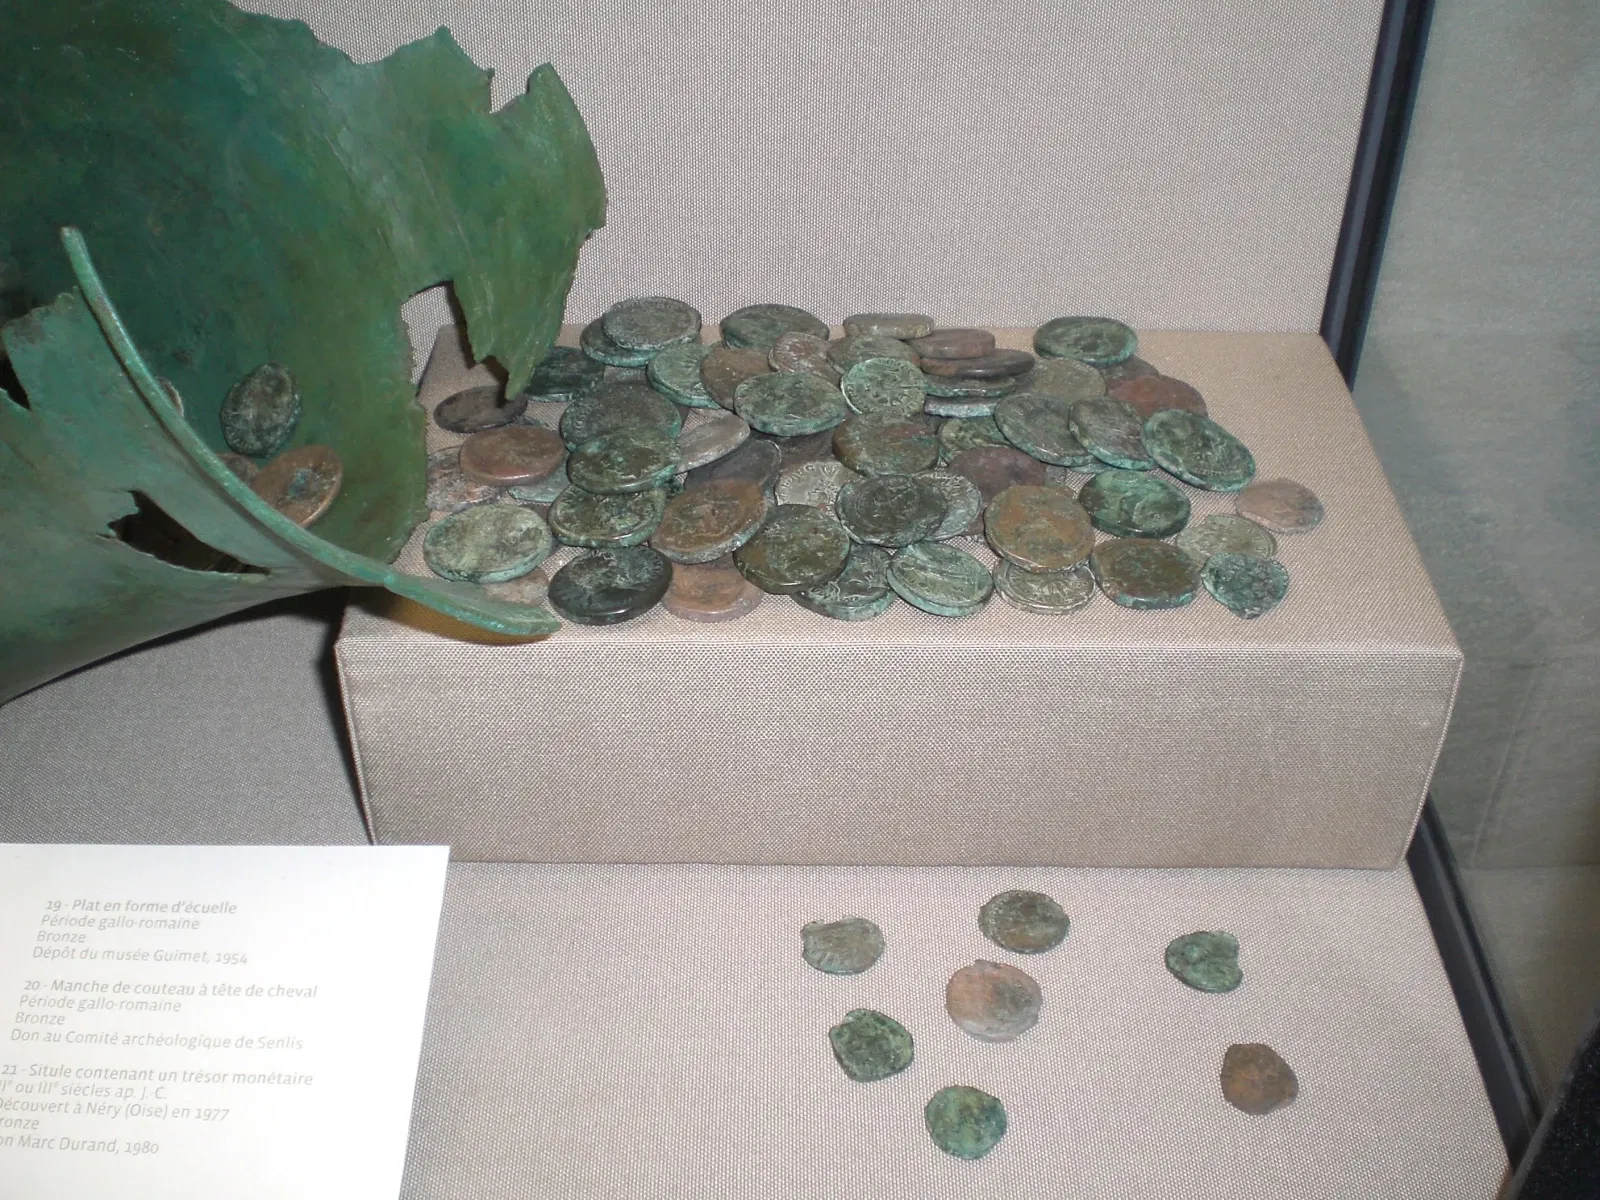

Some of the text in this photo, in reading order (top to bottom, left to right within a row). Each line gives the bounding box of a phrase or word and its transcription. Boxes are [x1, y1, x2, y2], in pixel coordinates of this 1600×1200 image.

[45, 900, 62, 913] 19
[72, 899, 101, 912] Plat
[103, 902, 121, 912] en
[124, 899, 168, 913] forme
[41, 914, 200, 931] Période gallo-romaine
[37, 930, 87, 944] Bronze
[32, 946, 248, 965] Dépôt du musée Guimet, 1954
[23, 980, 41, 991] 20
[51, 979, 109, 994] Manche
[112, 980, 131, 994] de
[134, 983, 195, 996] couteau
[198, 983, 208, 996] à
[211, 983, 242, 997] tête
[245, 984, 264, 997] de
[267, 984, 318, 998] cheval
[20, 994, 182, 1013] Période gallo-romaine
[15, 1011, 65, 1026] Bronze
[10, 1028, 304, 1050] Don au Comité archéologique de Senlis
[1, 1064, 18, 1076] 21
[28, 1063, 72, 1078] Situle
[75, 1067, 154, 1082] contenant
[158, 1070, 178, 1082] un
[182, 1069, 229, 1084] trésor
[232, 1071, 314, 1086] monétaire
[15, 1083, 34, 1094] ou
[60, 1083, 111, 1098] siècles
[114, 1086, 137, 1101] ap.
[72, 1101, 82, 1115] à
[85, 1101, 122, 1119] Néry
[124, 1103, 168, 1120] (Oise)
[171, 1108, 190, 1119] en
[194, 1108, 230, 1122] 1977
[0, 1117, 40, 1131] ronze
[17, 1134, 55, 1150] Marc
[59, 1136, 120, 1155] Durand,
[124, 1140, 160, 1156] 1980
